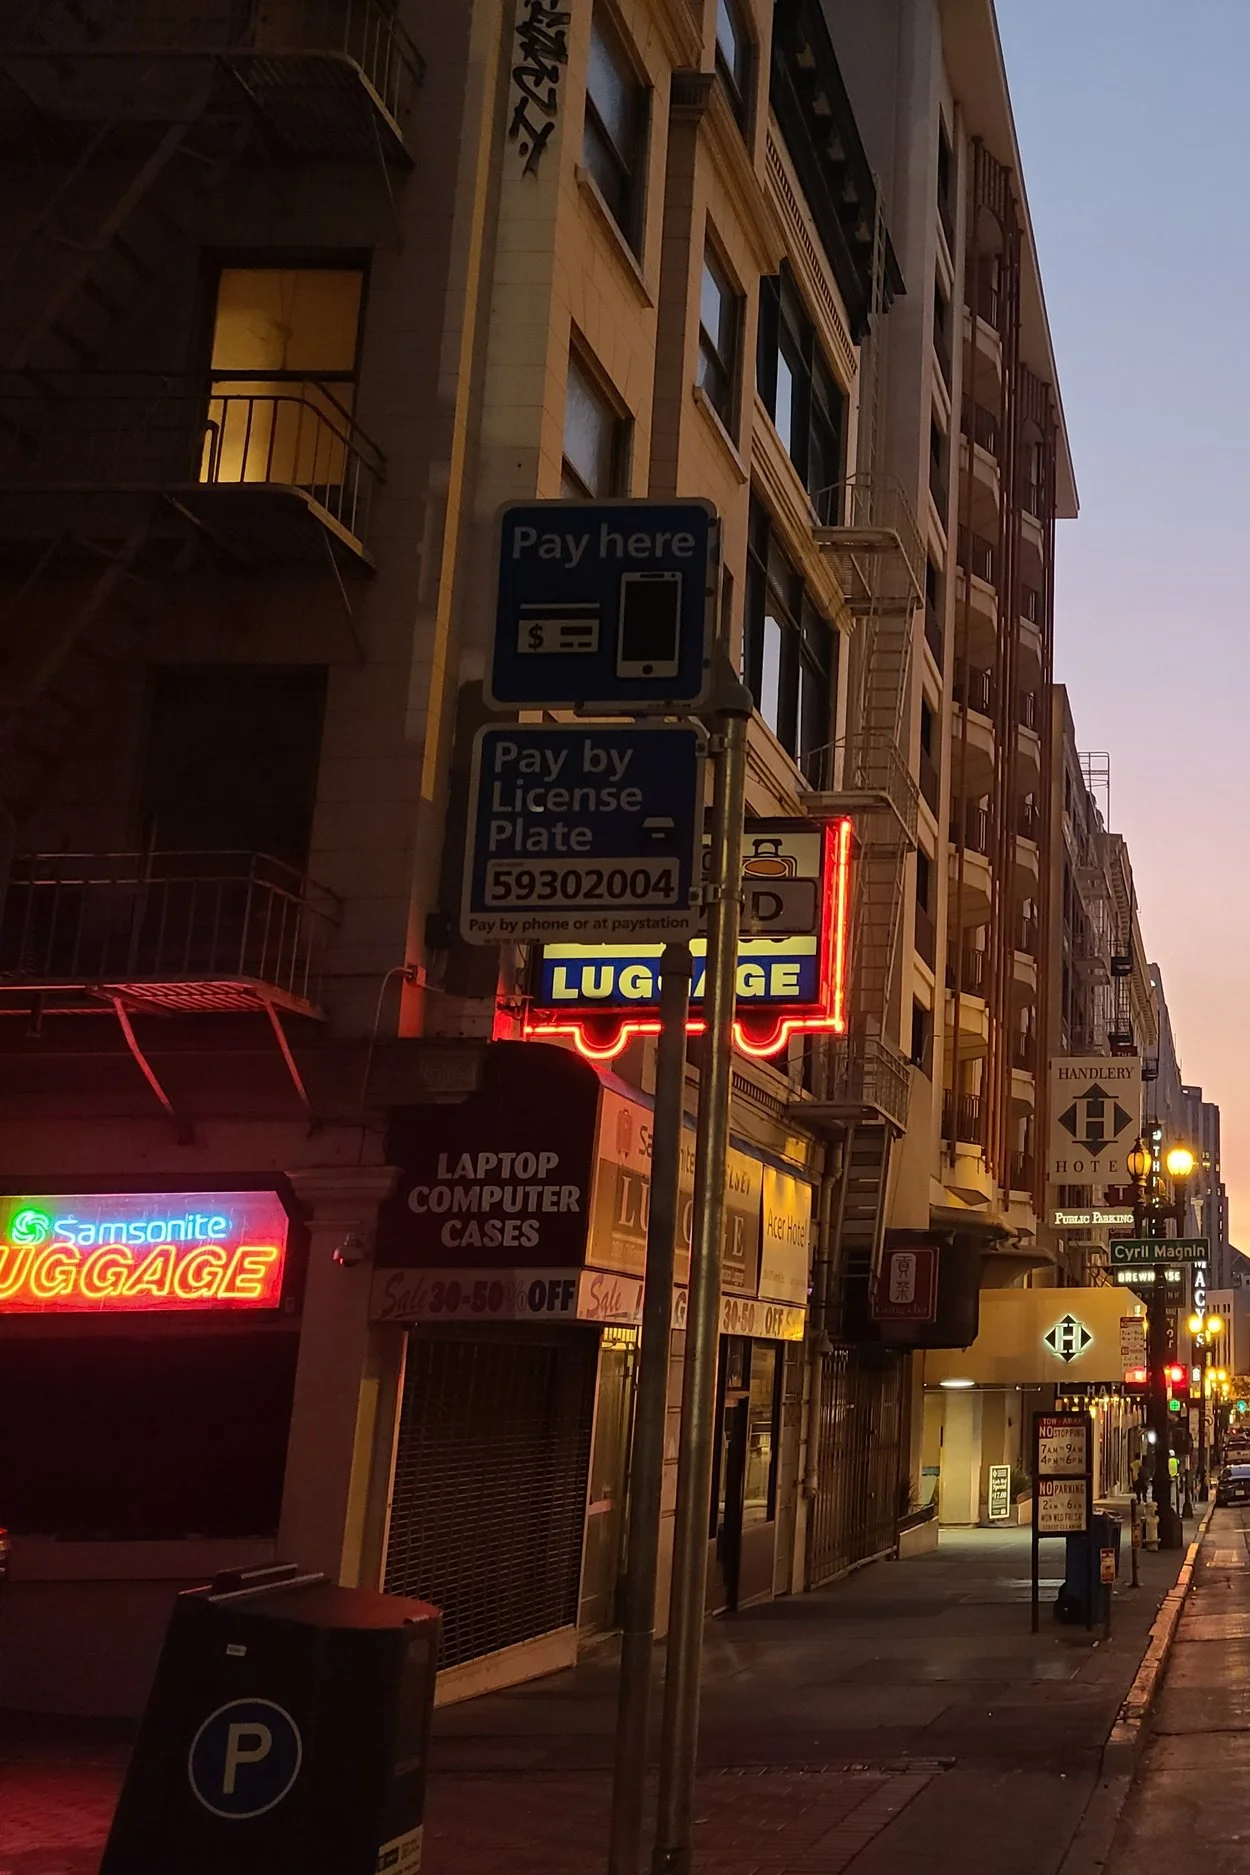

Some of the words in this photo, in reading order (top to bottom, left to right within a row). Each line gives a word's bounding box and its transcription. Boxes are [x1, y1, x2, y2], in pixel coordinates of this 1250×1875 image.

[511, 525, 589, 570] Pay
[599, 523, 696, 559] here
[493, 741, 568, 783] Pay
[582, 739, 635, 780] by
[491, 779, 644, 813] License
[488, 819, 593, 852] Plate
[491, 868, 675, 901] 59302004
[469, 918, 496, 934] Pay
[500, 917, 519, 933] by
[522, 916, 569, 932] phone
[573, 918, 590, 930] or
[593, 916, 609, 930] at
[611, 915, 689, 932] paystation
[551, 963, 801, 1000] LUGGE
[1058, 1067, 1134, 1081] HANDLERY
[437, 1150, 560, 1181] LAPTOP
[1055, 1160, 1118, 1174] HOTE
[407, 1184, 581, 1214] COMPUTER
[53, 1213, 229, 1247] Samsonite
[440, 1218, 542, 1249] CASES
[766, 1208, 786, 1241] Acer
[1054, 1212, 1090, 1225] PUBLIC
[1092, 1211, 1135, 1224] PARKING
[1114, 1244, 1149, 1261] Cyril
[1154, 1244, 1205, 1261] Magnin
[1117, 1271, 1181, 1283] BREWHSE
[381, 1272, 428, 1318] Sale
[528, 1279, 576, 1312] OFF
[586, 1275, 622, 1318] Sale
[765, 1306, 784, 1336] OFF
[1039, 1426, 1053, 1438] NO
[1053, 1428, 1085, 1438] STOPPING
[1039, 1481, 1053, 1496] NO
[1054, 1483, 1085, 1495] PARKING
[222, 1722, 273, 1795] P
